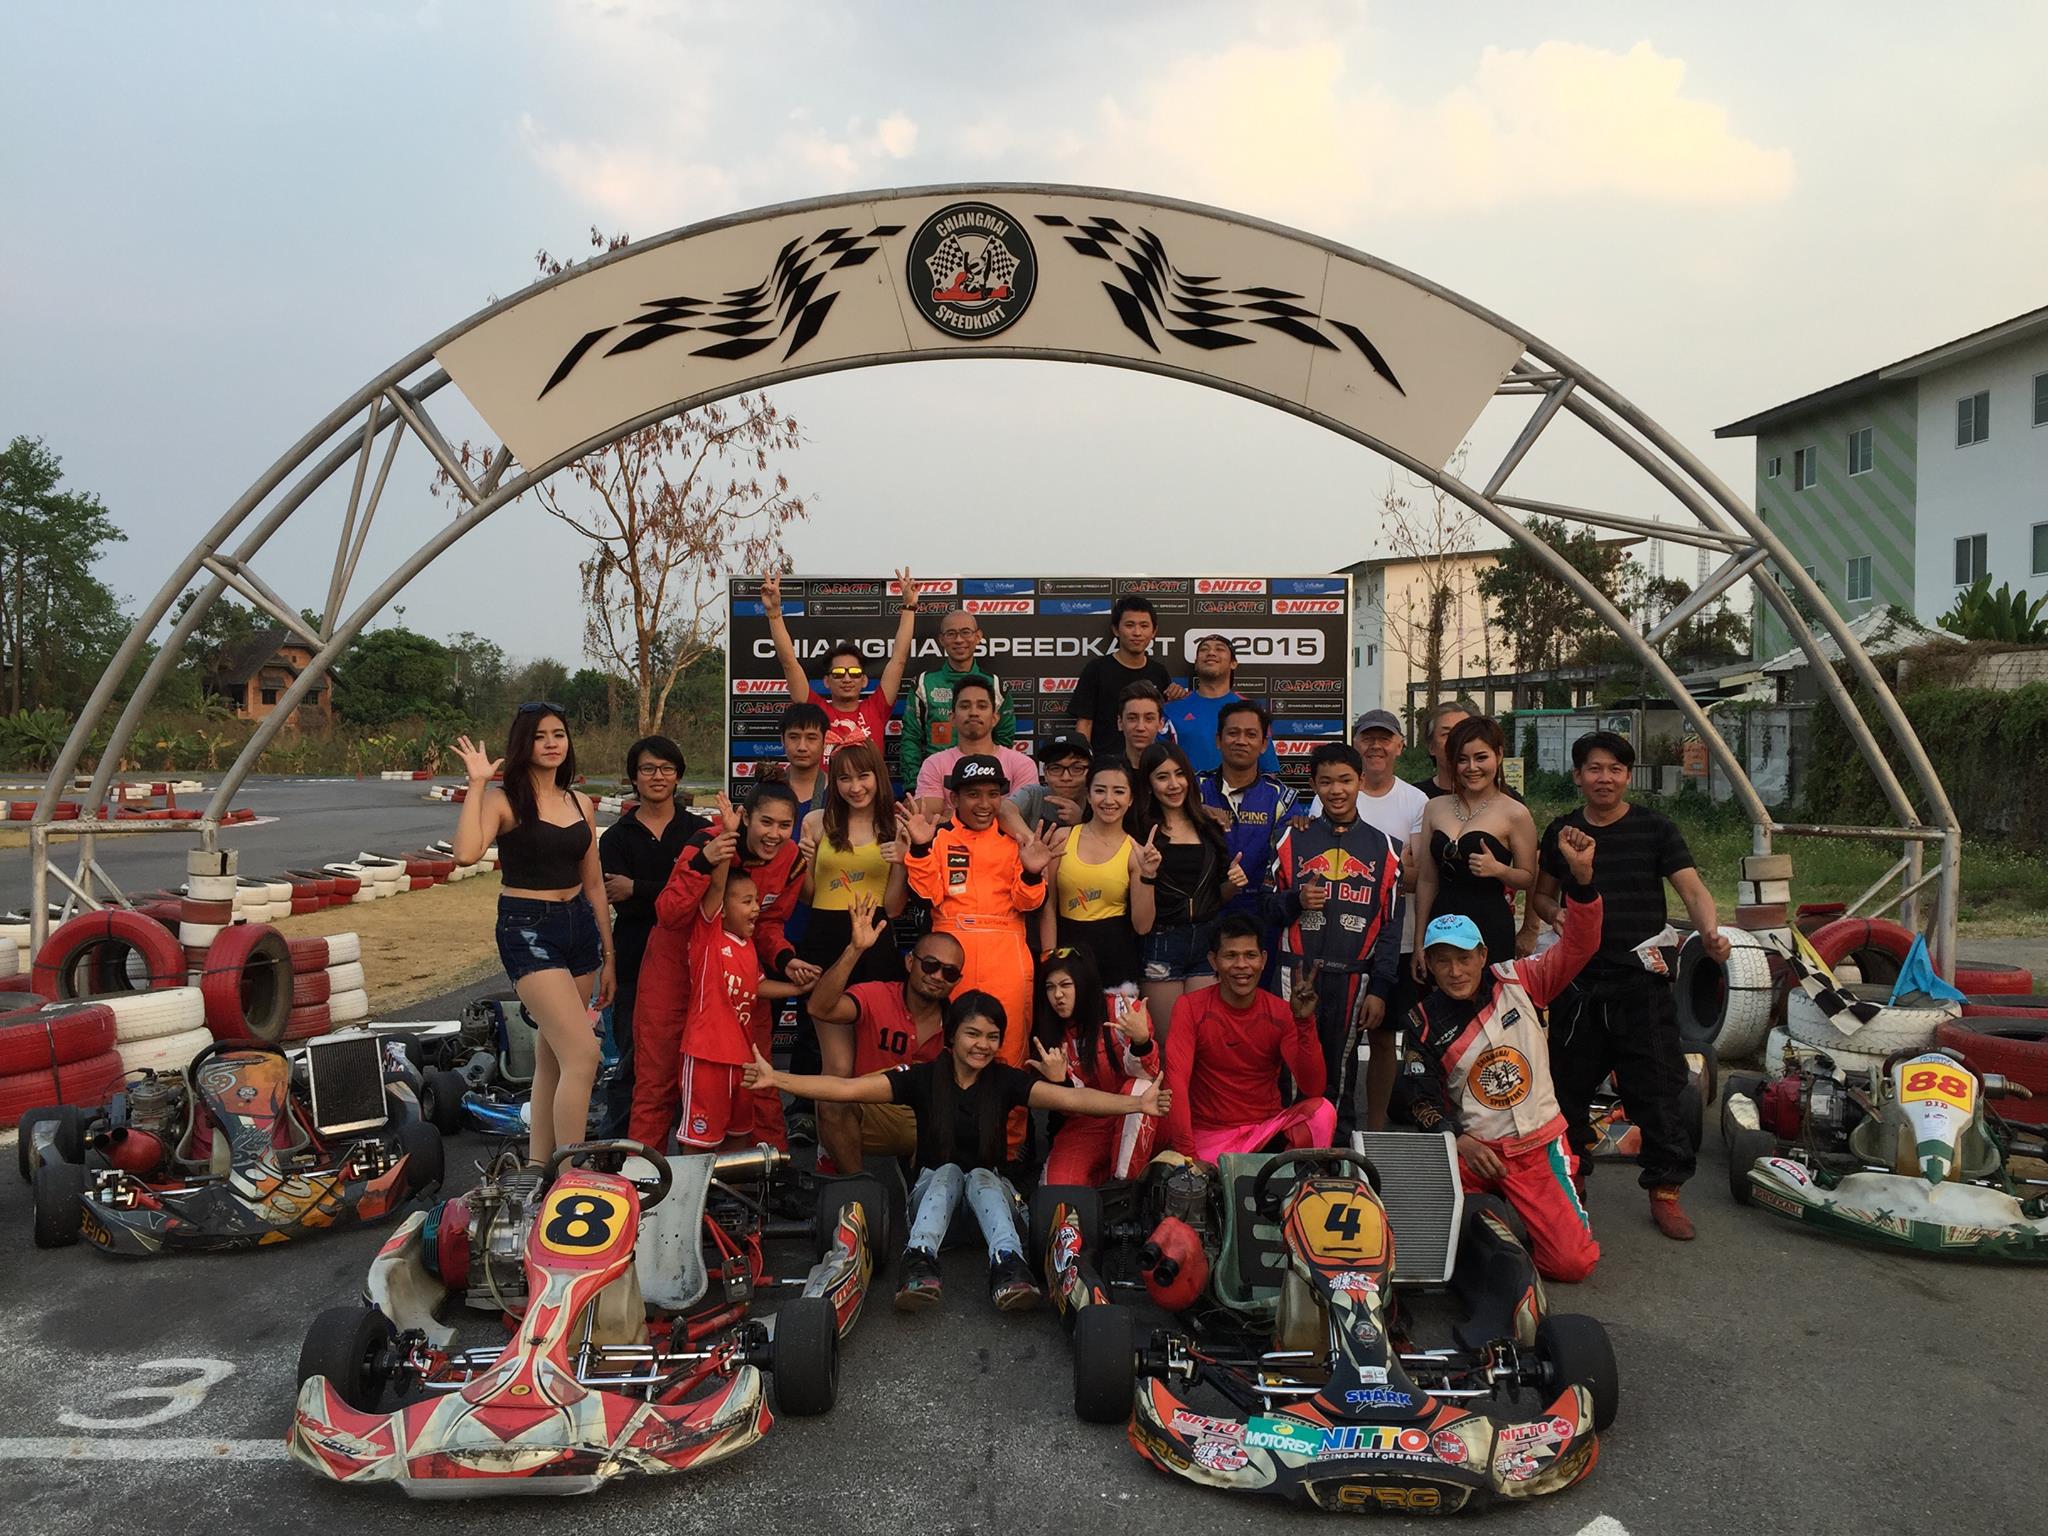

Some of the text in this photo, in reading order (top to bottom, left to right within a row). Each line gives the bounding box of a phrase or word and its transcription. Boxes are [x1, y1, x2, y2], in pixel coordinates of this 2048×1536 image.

[935, 212, 1009, 238] CHIANGMAI
[935, 304, 1006, 330] SPEEDKART
[1211, 580, 1262, 591] NITTO
[980, 600, 1030, 612] NITTO
[1288, 600, 1340, 611] NITTO
[962, 762, 996, 779] Beer
[1338, 882, 1372, 904] Bull
[878, 1027, 909, 1056] 10
[1906, 1071, 1968, 1099] 88
[546, 1195, 615, 1248] 8
[1324, 1203, 1361, 1241] 4
[57, 1358, 237, 1430] 3
[1345, 1389, 1413, 1406] SHARK
[1176, 1411, 1240, 1434] NITTO
[1499, 1422, 1549, 1441] NITTO
[322, 1439, 361, 1455] KART
[1245, 1430, 1315, 1456] MOTOREX
[1317, 1426, 1430, 1453] NITTO
[1316, 1453, 1434, 1464] ACING PERFORMANCE
[1338, 1485, 1441, 1510] CRG
